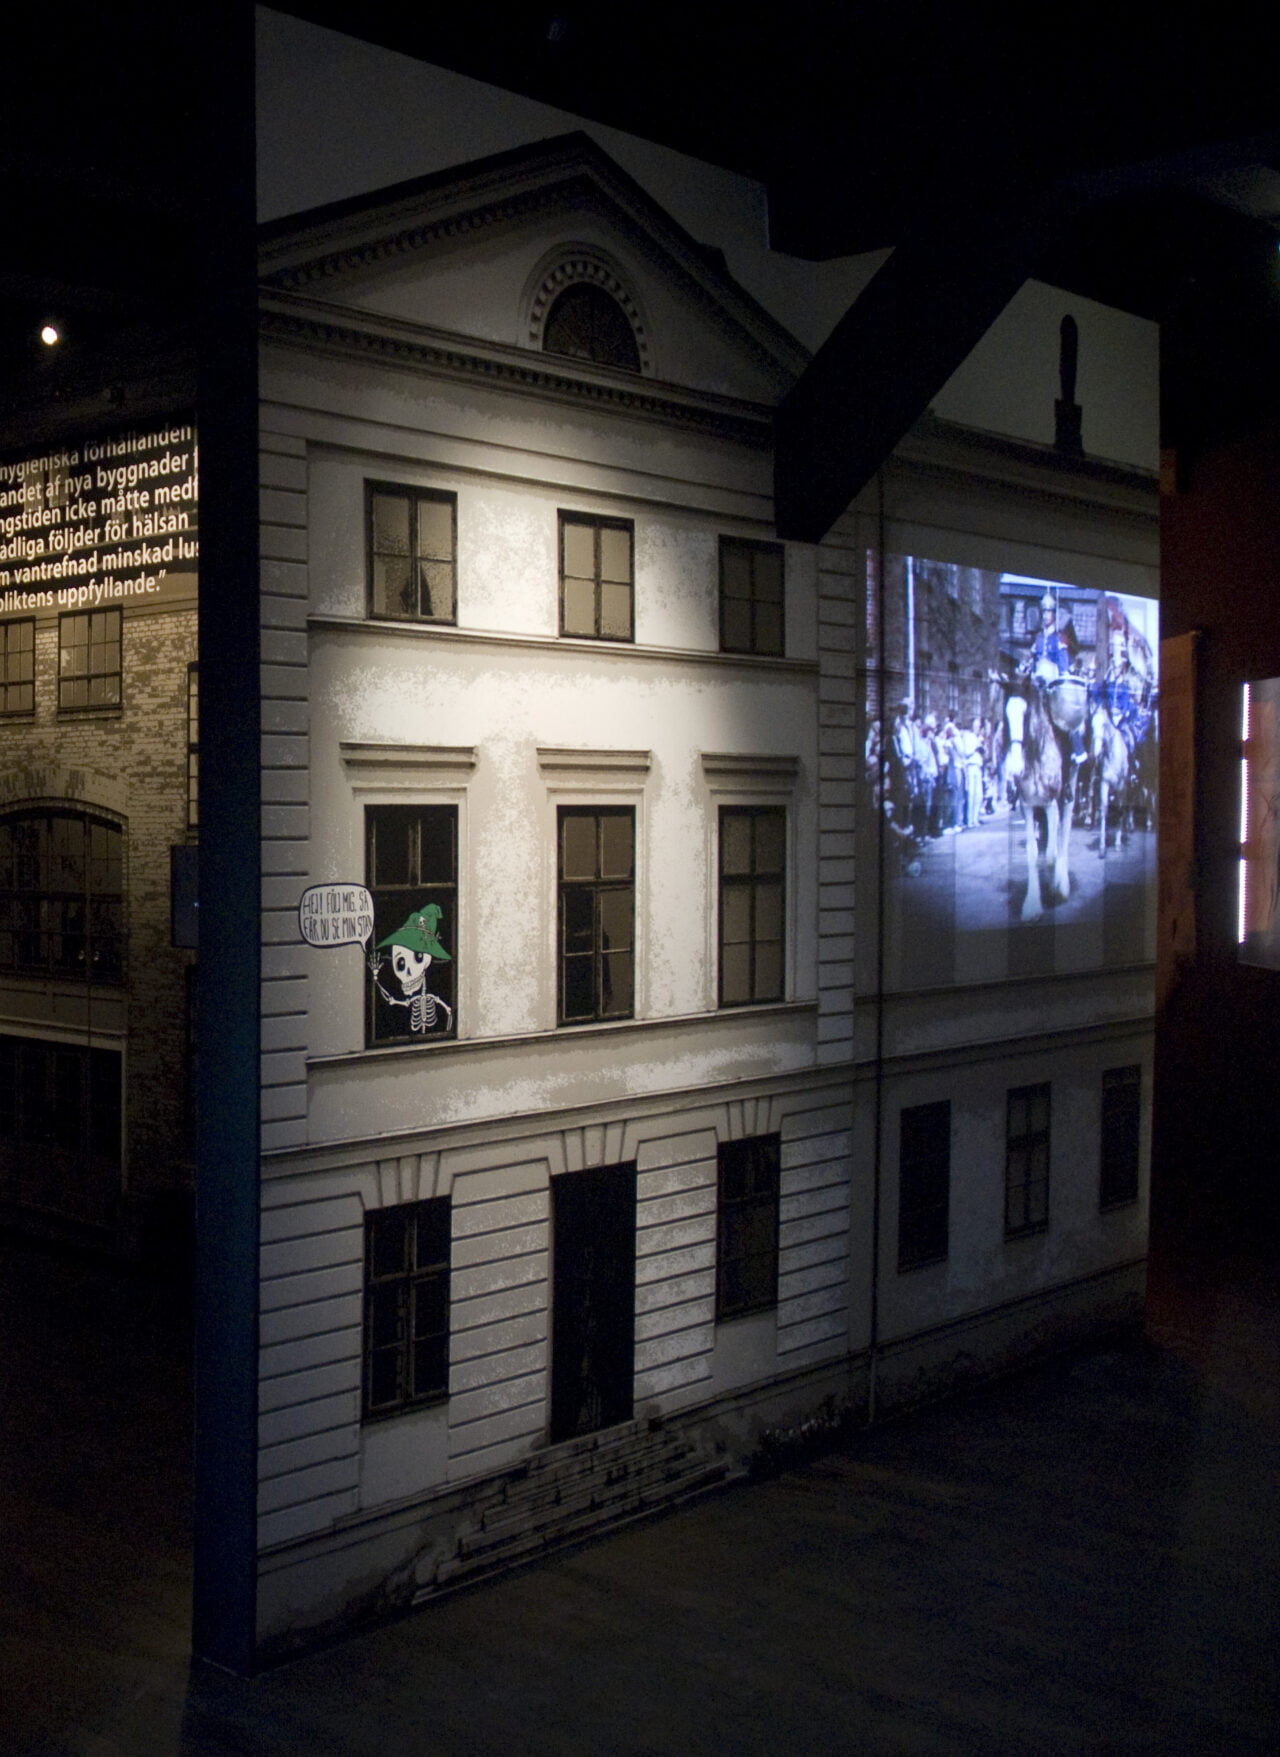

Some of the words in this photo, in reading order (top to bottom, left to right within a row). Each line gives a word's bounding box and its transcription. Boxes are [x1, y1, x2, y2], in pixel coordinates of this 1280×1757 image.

[0, 446, 79, 483] hygieniska
[84, 423, 192, 464] förhållanden
[46, 475, 62, 498] af
[65, 476, 92, 498] nya
[97, 451, 189, 491] byggnader
[66, 498, 97, 521] icke
[101, 488, 150, 515] måtte
[48, 524, 101, 554] följder
[104, 518, 129, 542] för
[133, 511, 189, 538] hälsan
[14, 550, 98, 584] vantrefnad
[102, 538, 173, 571] minskad
[303, 892, 323, 915] HEJ!
[326, 888, 341, 913] FÖLJ
[359, 889, 370, 911] SÅ
[303, 916, 320, 941] FÅR
[320, 918, 330, 941] DU
[331, 917, 340, 940] SE
[342, 917, 356, 938] MIN
